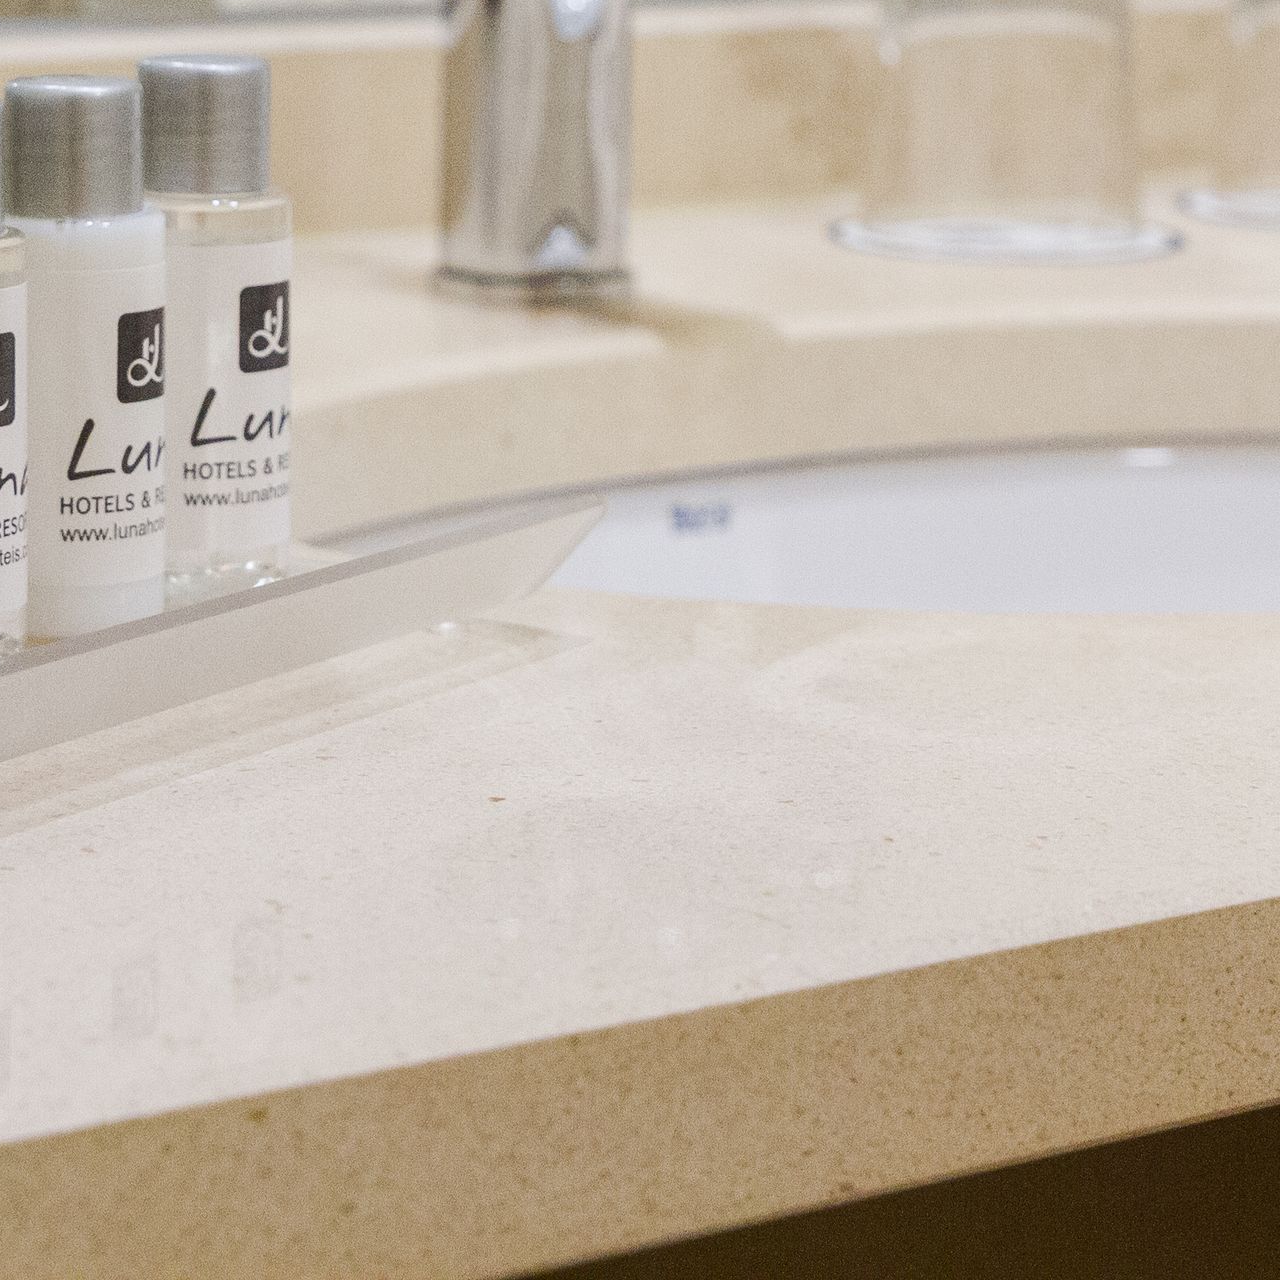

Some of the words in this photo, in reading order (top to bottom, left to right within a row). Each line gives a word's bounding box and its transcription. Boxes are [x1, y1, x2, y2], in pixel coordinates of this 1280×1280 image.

[183, 459, 257, 480] HOTELS
[263, 457, 273, 475] &
[60, 492, 135, 515] HOTELS
[141, 490, 151, 508] &
